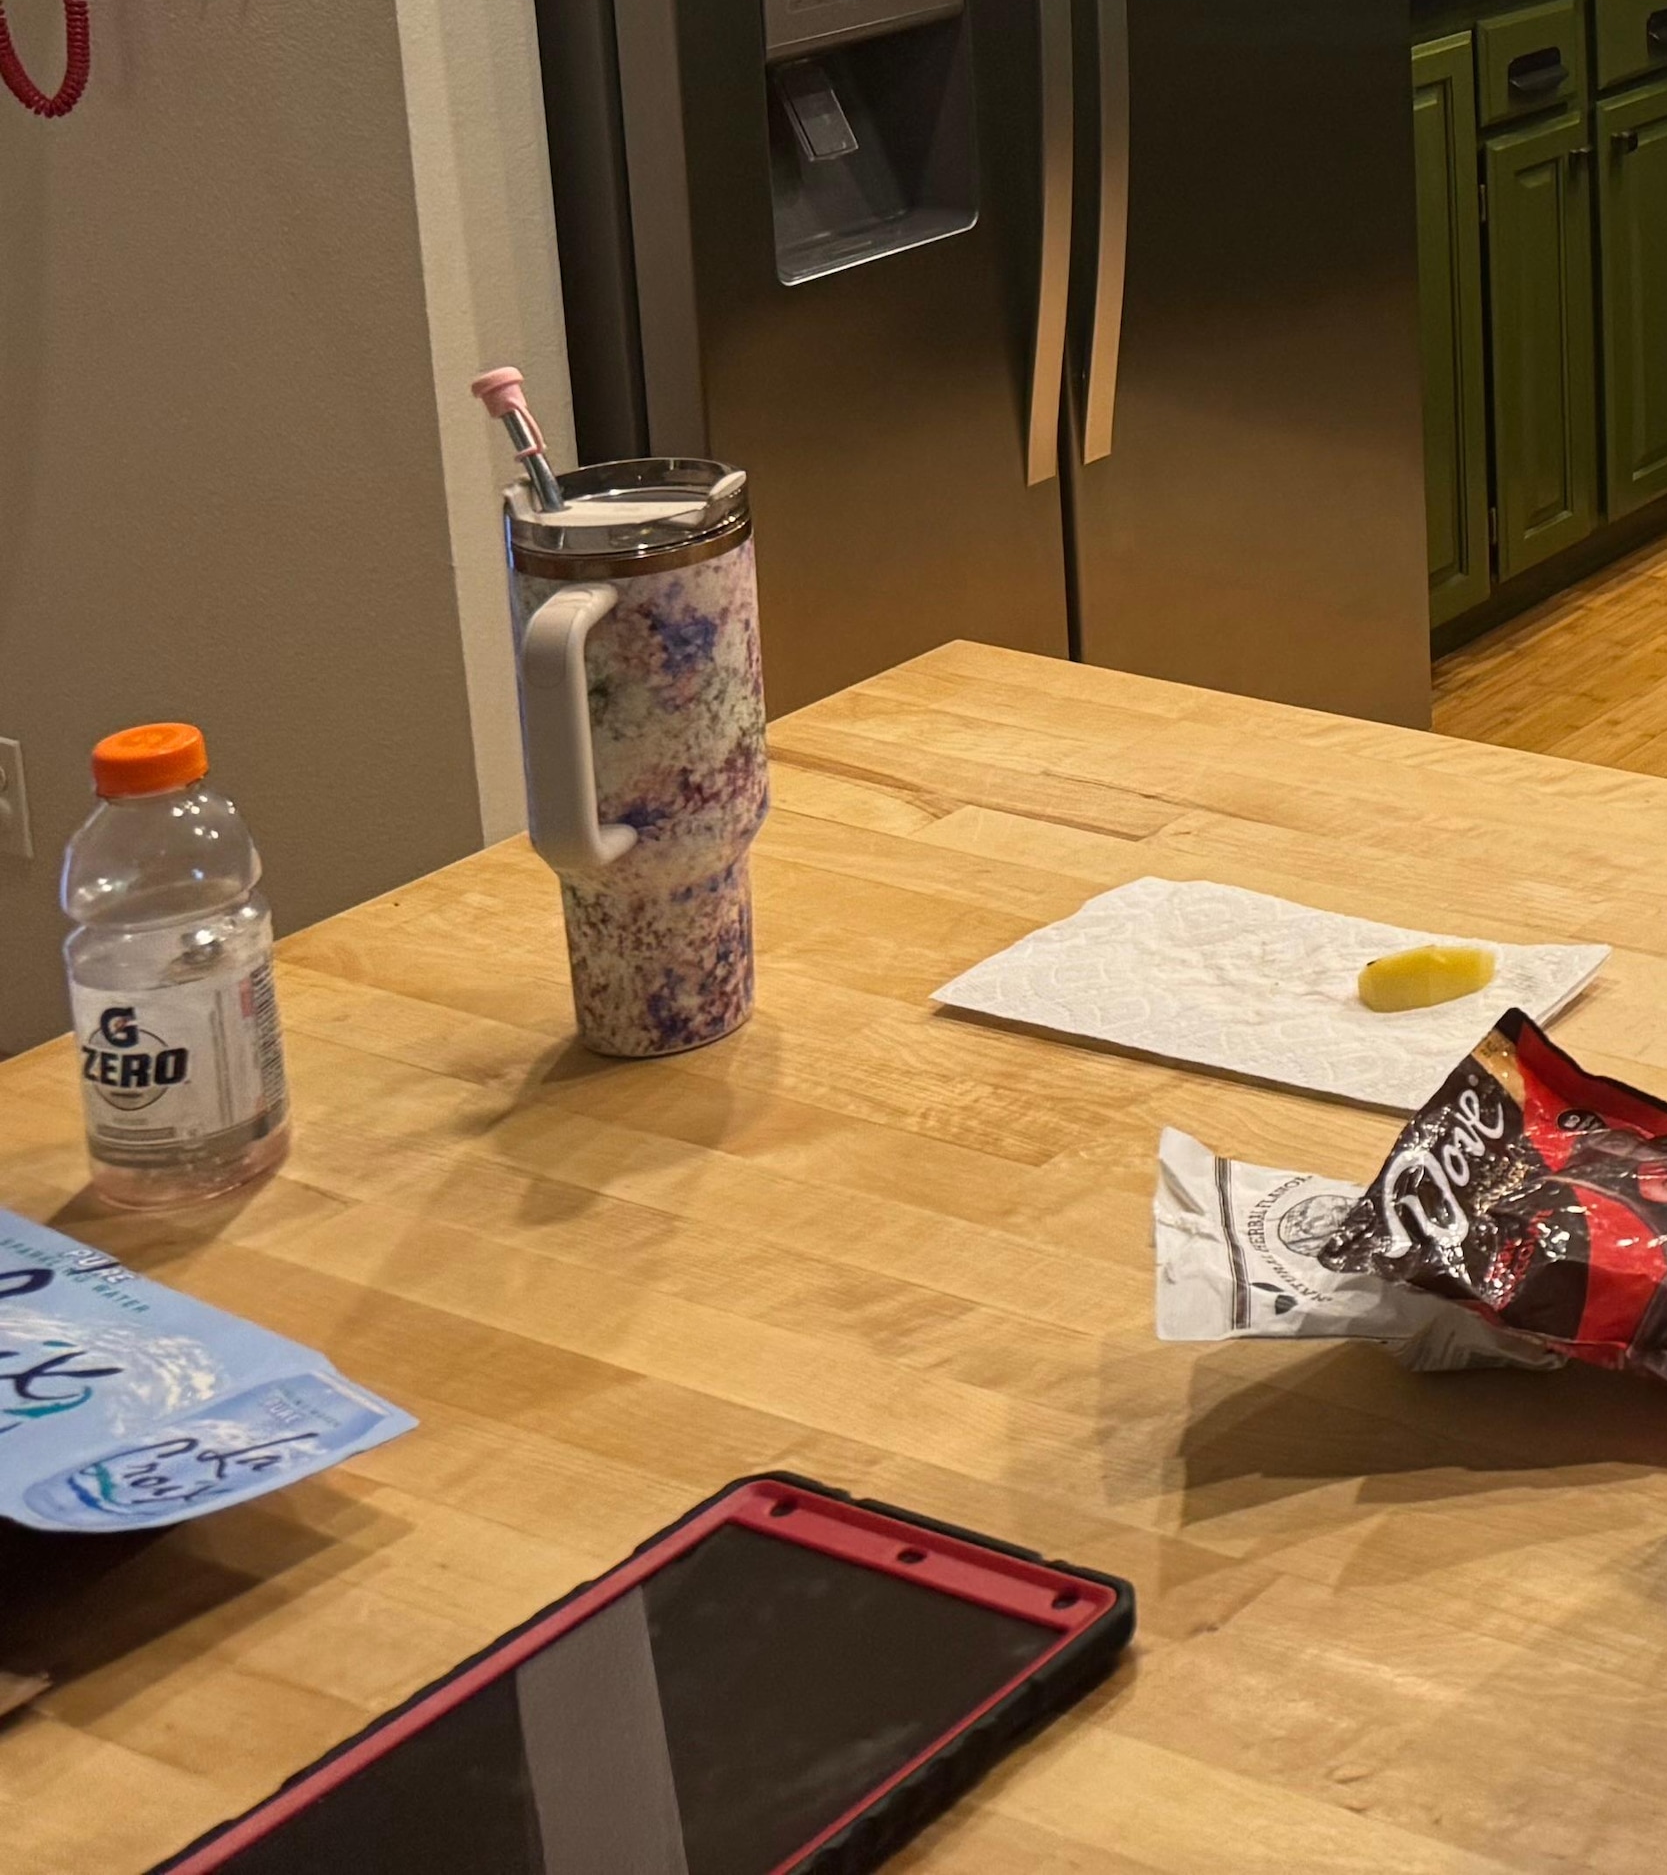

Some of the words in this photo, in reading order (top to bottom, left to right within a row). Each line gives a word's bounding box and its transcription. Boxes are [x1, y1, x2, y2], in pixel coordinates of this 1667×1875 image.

[100, 1006, 138, 1049] G
[81, 1045, 189, 1089] ZERO
[1378, 1085, 1507, 1260] Dove
[92, 1283, 150, 1313] WATER
